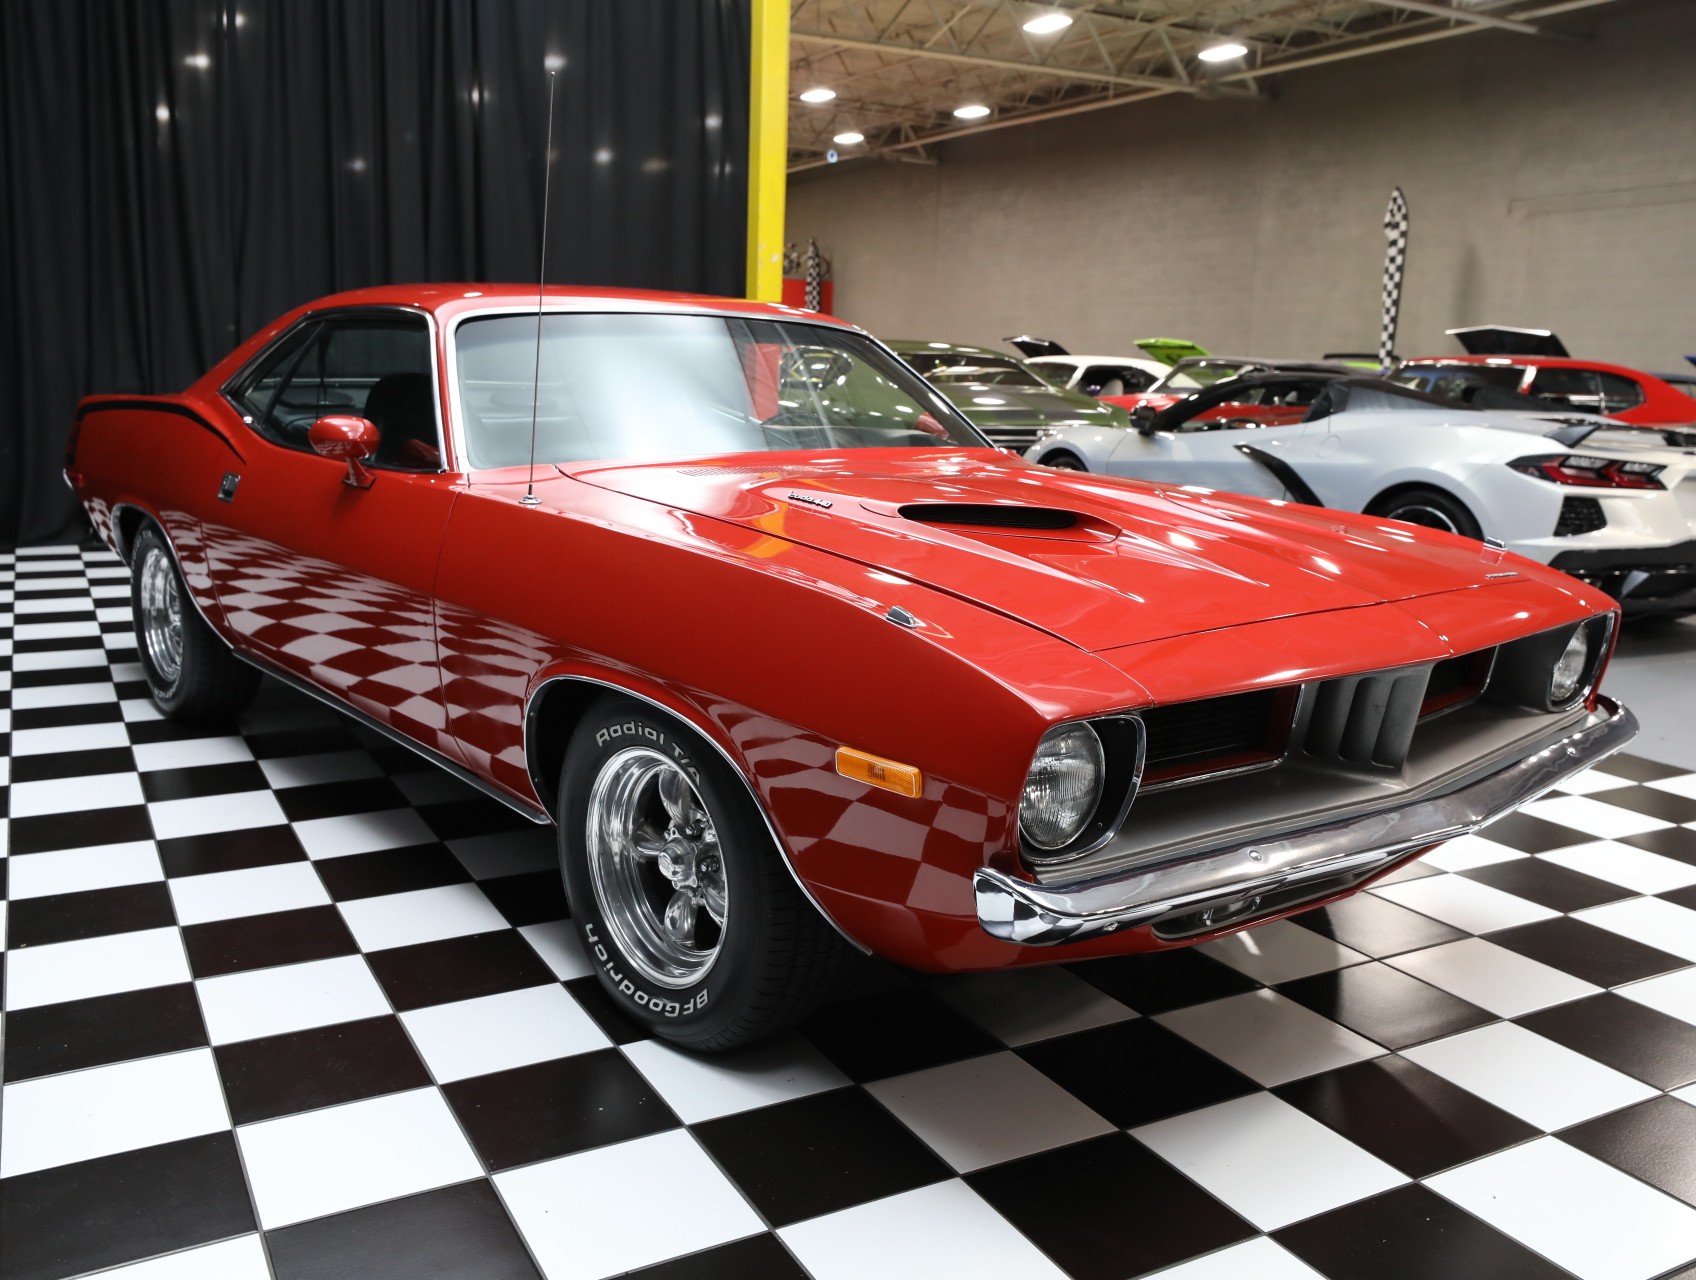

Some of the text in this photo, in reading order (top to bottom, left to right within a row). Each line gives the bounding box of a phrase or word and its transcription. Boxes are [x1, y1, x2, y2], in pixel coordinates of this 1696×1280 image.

[595, 721, 701, 786] Radial T/A
[585, 923, 709, 1018] BFGoodrich
